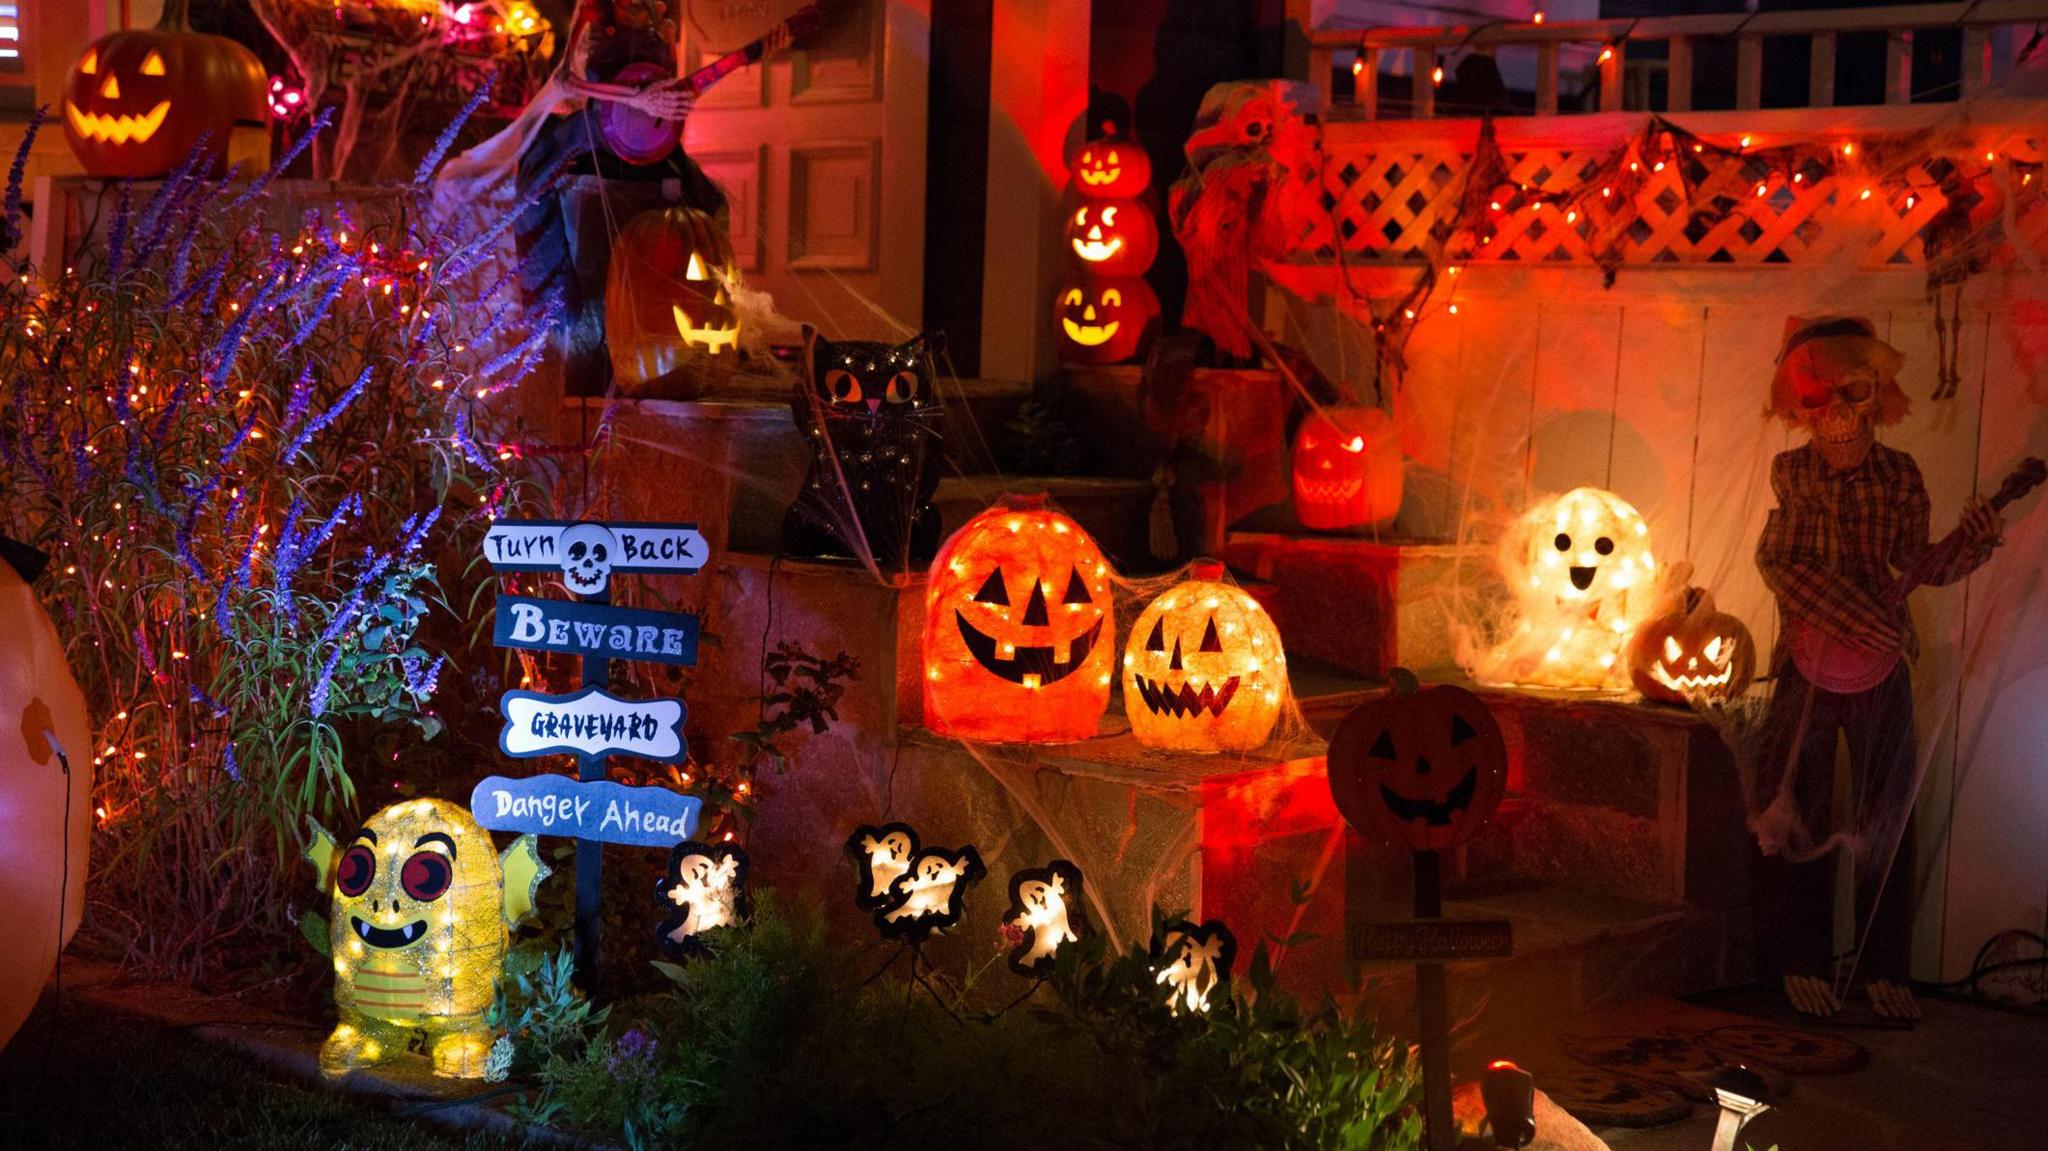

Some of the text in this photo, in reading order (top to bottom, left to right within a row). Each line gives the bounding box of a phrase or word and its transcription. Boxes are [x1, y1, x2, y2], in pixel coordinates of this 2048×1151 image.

[488, 534, 694, 562] Turn Back
[531, 712, 658, 742] GRAVEYARD
[492, 790, 689, 839] Danger Ahead
